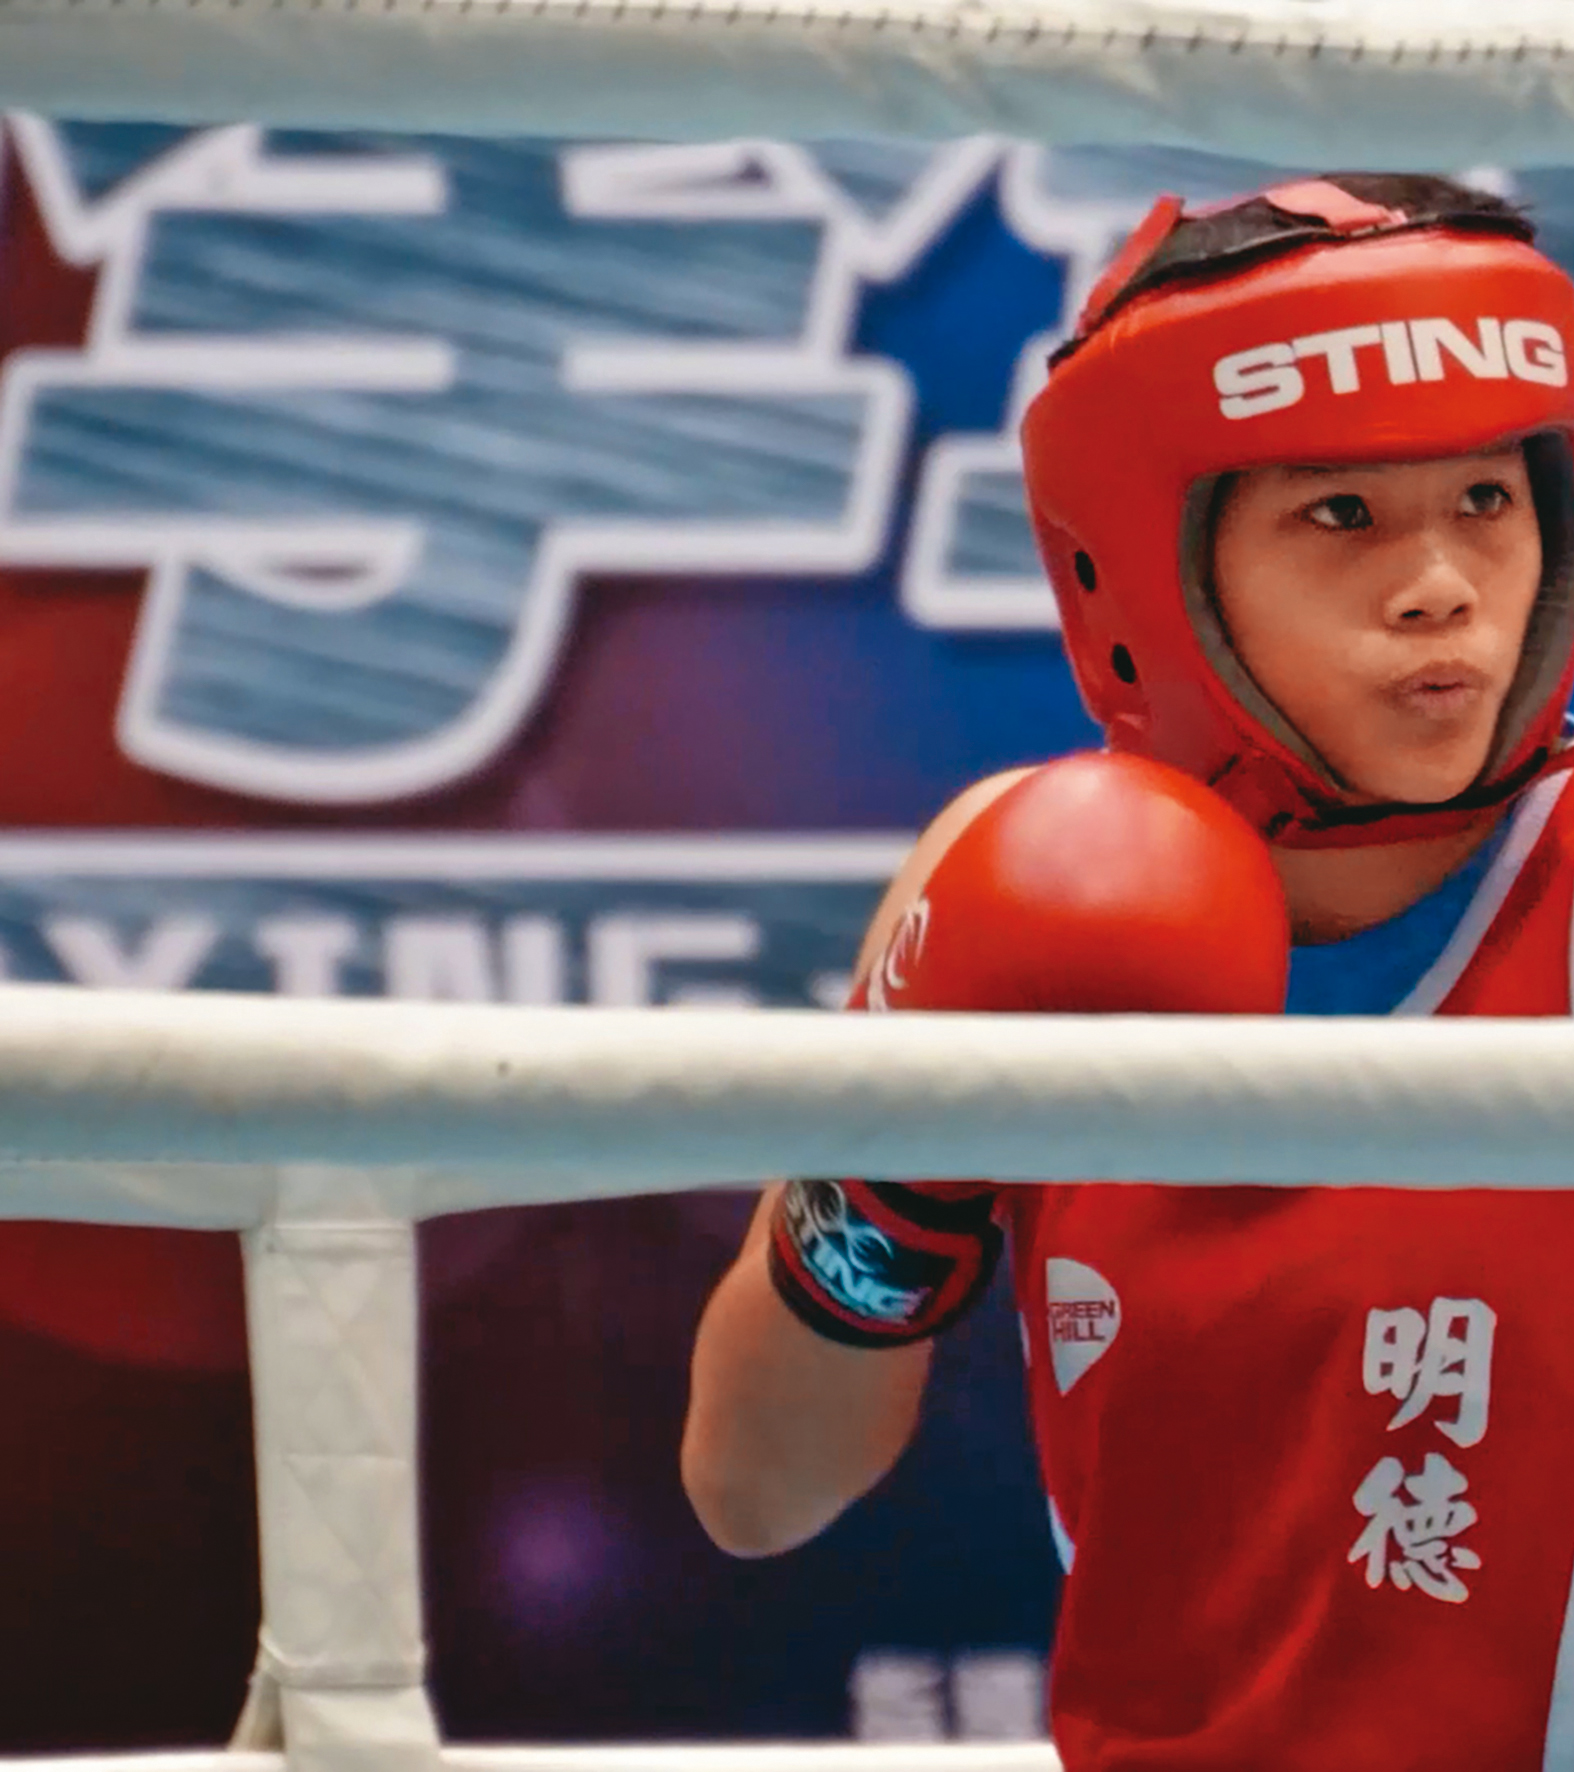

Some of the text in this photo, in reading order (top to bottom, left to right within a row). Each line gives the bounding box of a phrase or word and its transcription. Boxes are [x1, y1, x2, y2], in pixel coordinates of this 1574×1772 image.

[1213, 316, 1569, 421] STING
[1048, 1300, 1115, 1319] GREEN
[1052, 1320, 1106, 1342] HILL
[1348, 1297, 1497, 1604] 明德
